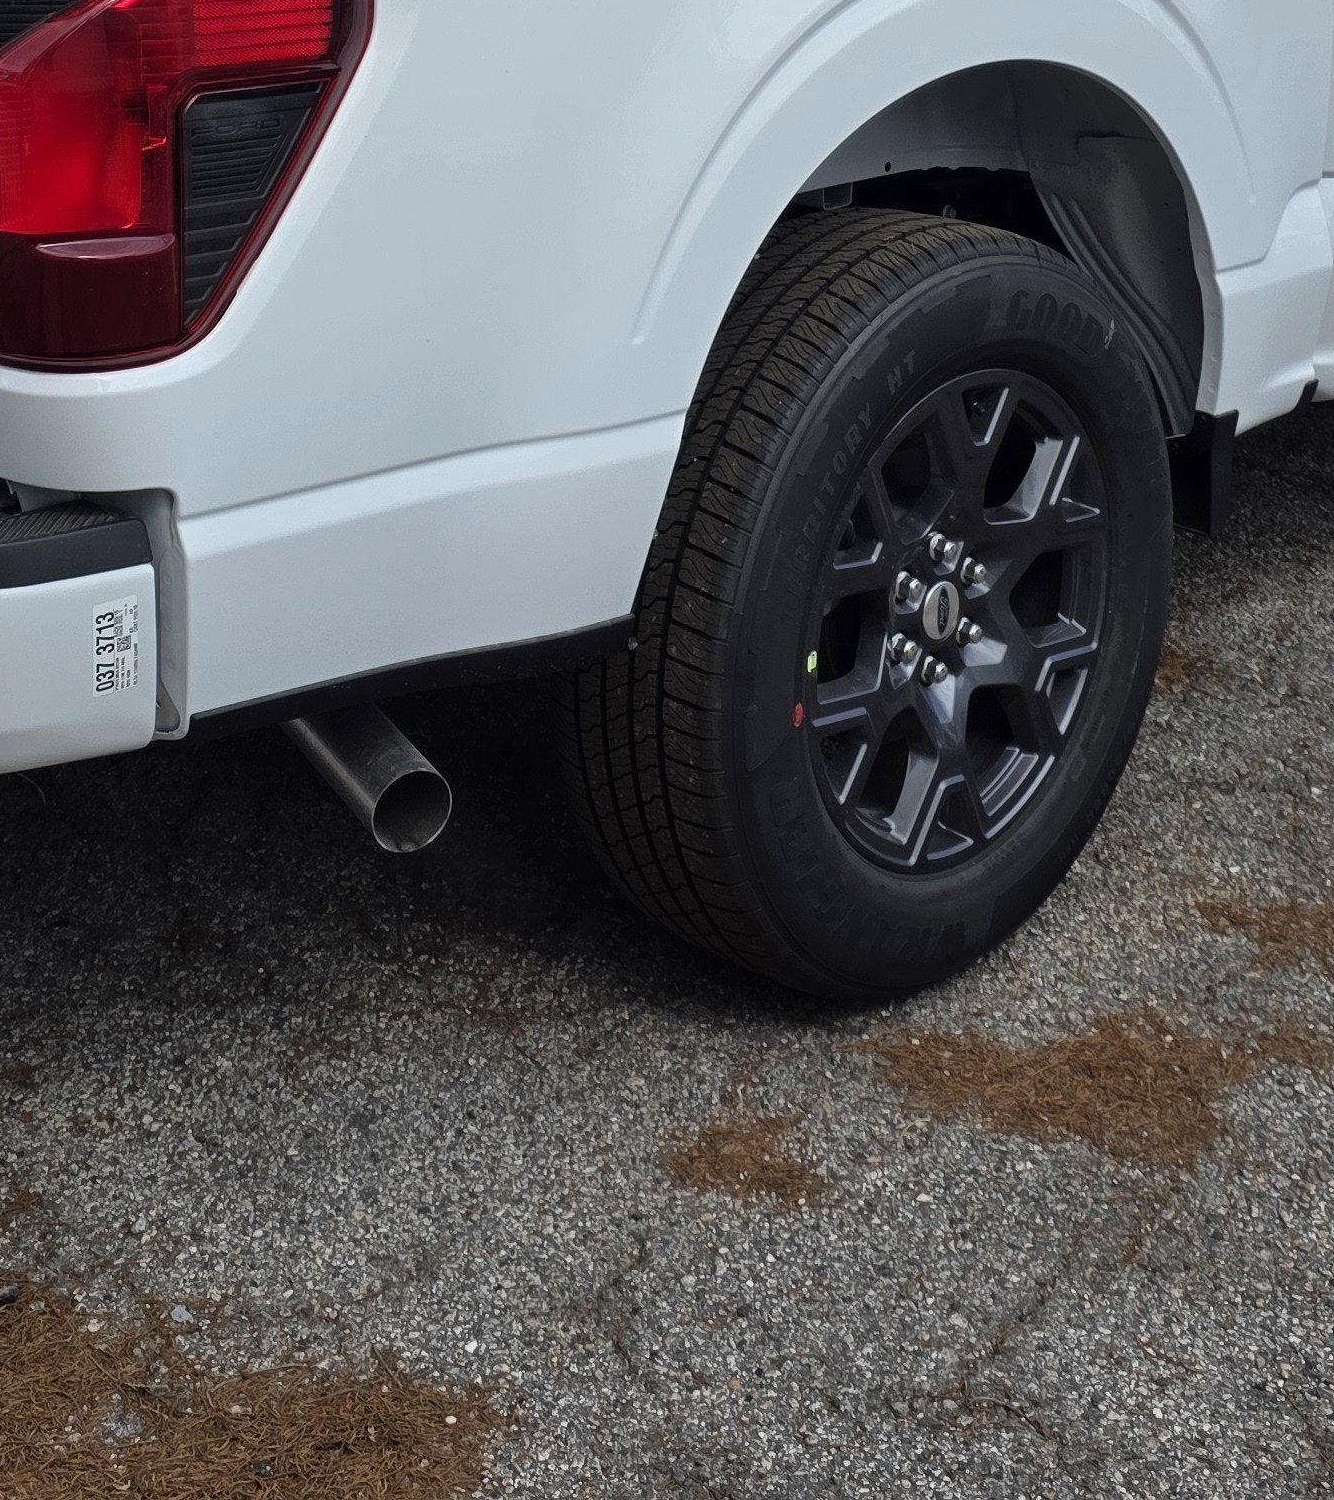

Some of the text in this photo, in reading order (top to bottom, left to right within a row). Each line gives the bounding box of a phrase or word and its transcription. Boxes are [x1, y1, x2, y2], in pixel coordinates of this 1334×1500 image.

[190, 117, 282, 139] FORD
[887, 349, 917, 396] HT
[95, 611, 115, 693] 037 3713
